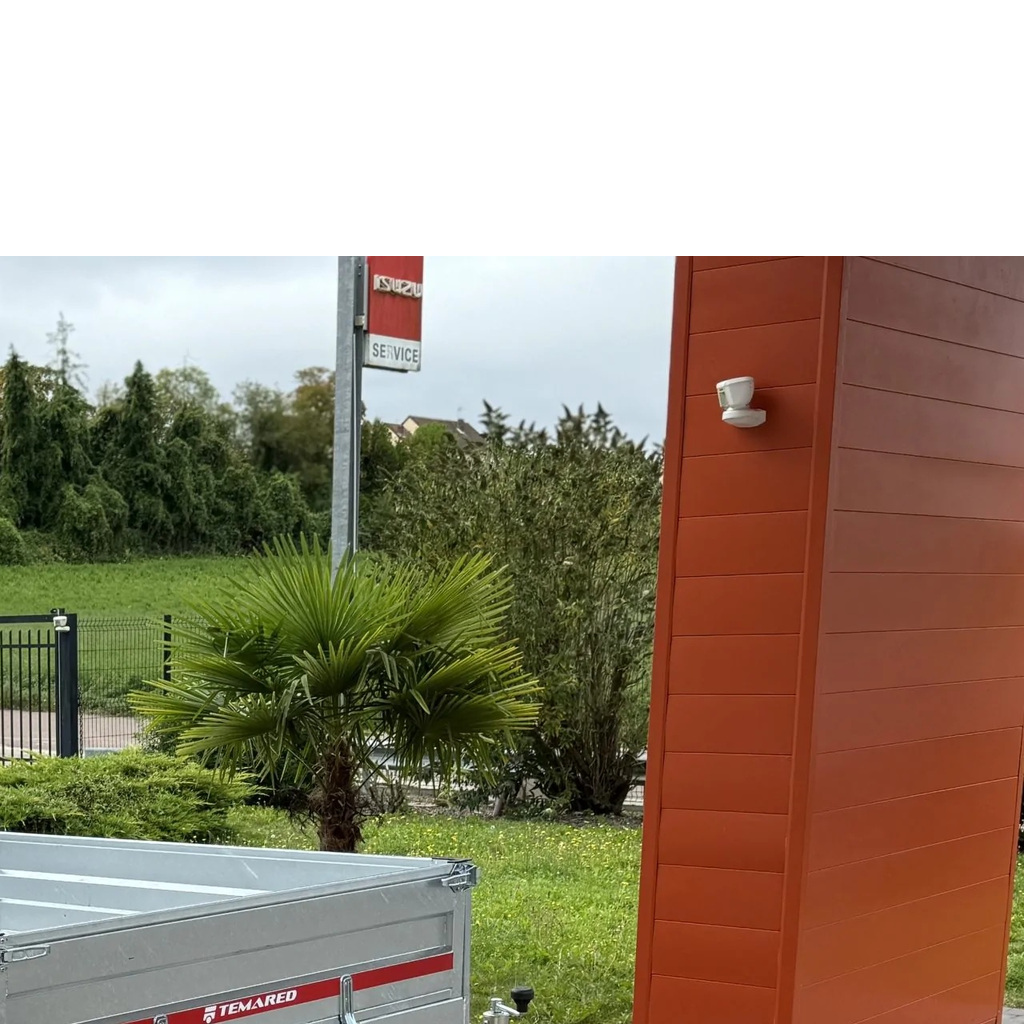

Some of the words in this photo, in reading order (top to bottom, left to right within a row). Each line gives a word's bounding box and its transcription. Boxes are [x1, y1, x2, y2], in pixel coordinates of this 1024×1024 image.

[374, 274, 423, 298] ISUZU
[372, 342, 419, 363] SERVICE
[219, 989, 298, 1017] TEMARED
